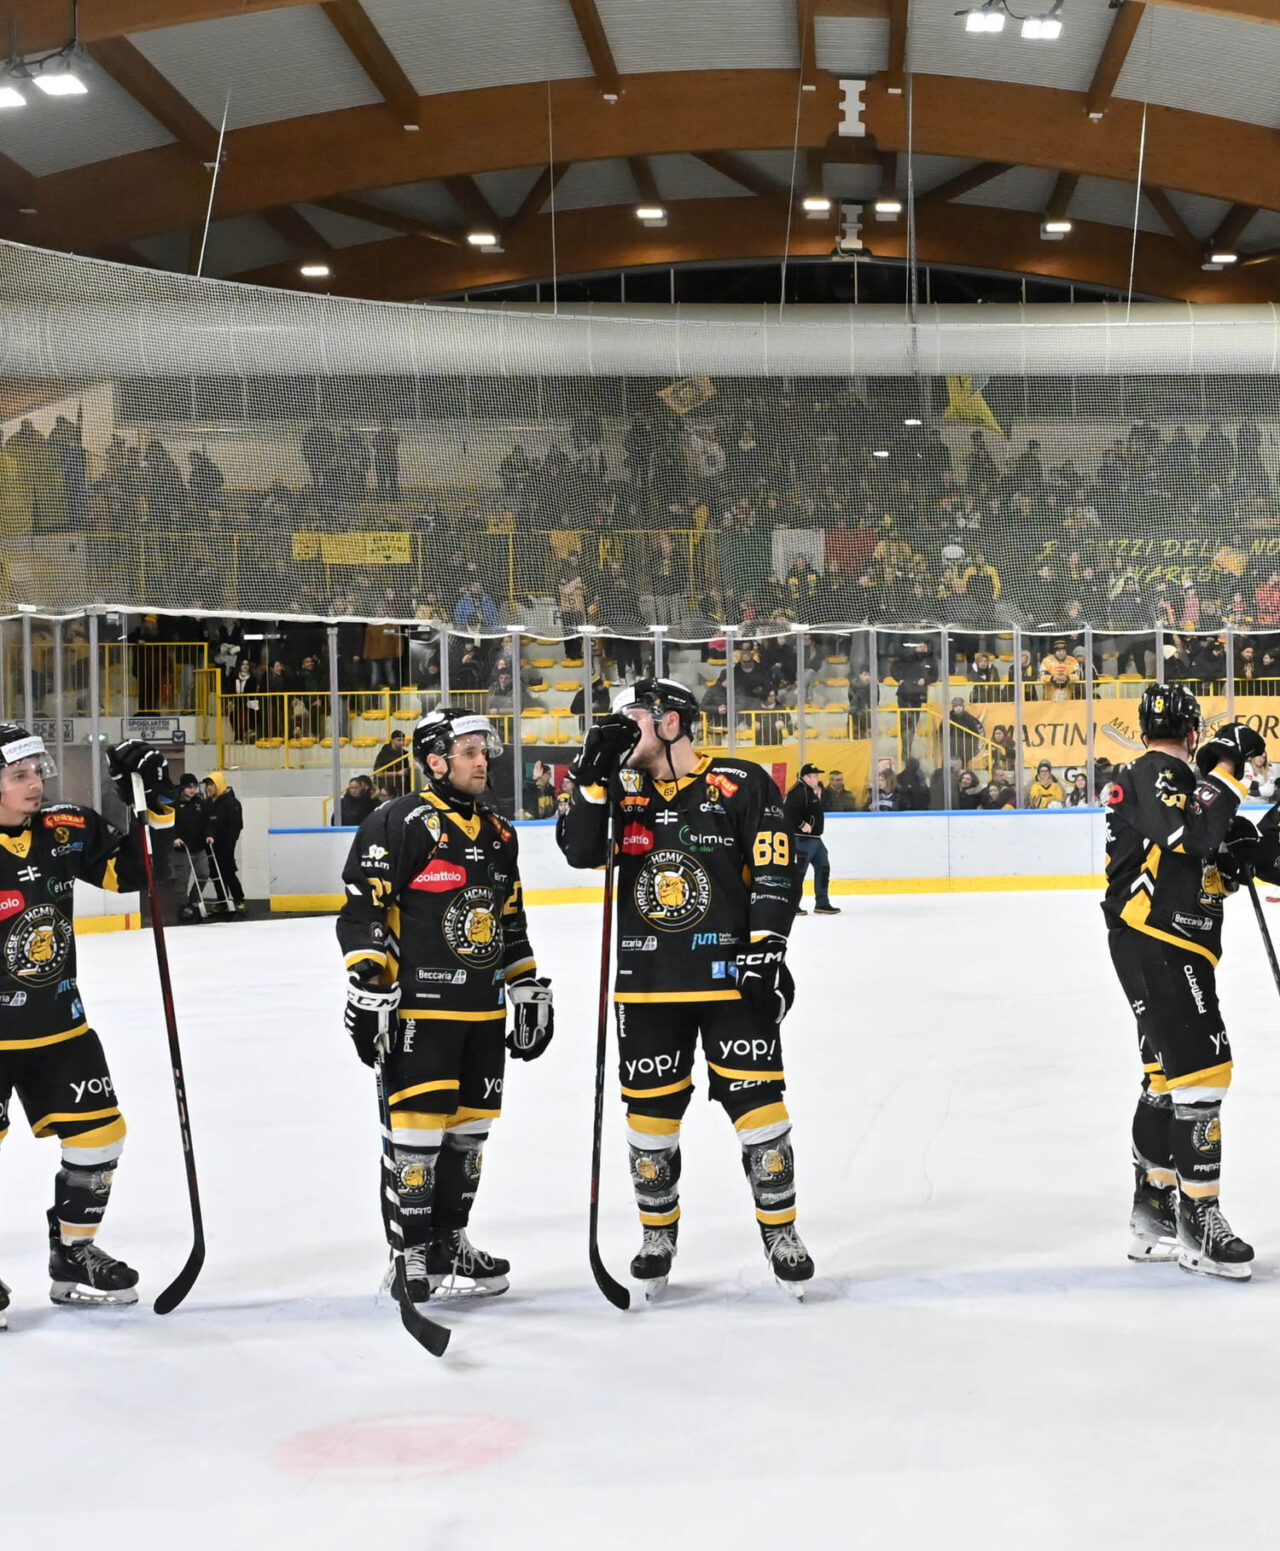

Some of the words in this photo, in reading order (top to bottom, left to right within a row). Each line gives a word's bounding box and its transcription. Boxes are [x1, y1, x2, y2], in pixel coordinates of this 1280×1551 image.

[651, 852, 683, 864] HCMV
[753, 831, 789, 866] 69
[415, 872, 461, 883] coiattolo
[637, 870, 651, 913] VARESE
[694, 869, 711, 913] HOCKEY
[444, 906, 459, 947] VARESE
[736, 951, 782, 965] CCM
[418, 969, 452, 980] Beccaria
[1184, 965, 1207, 1014] PRIMATO
[720, 1039, 776, 1061] yop!
[626, 1051, 680, 1081] yop!
